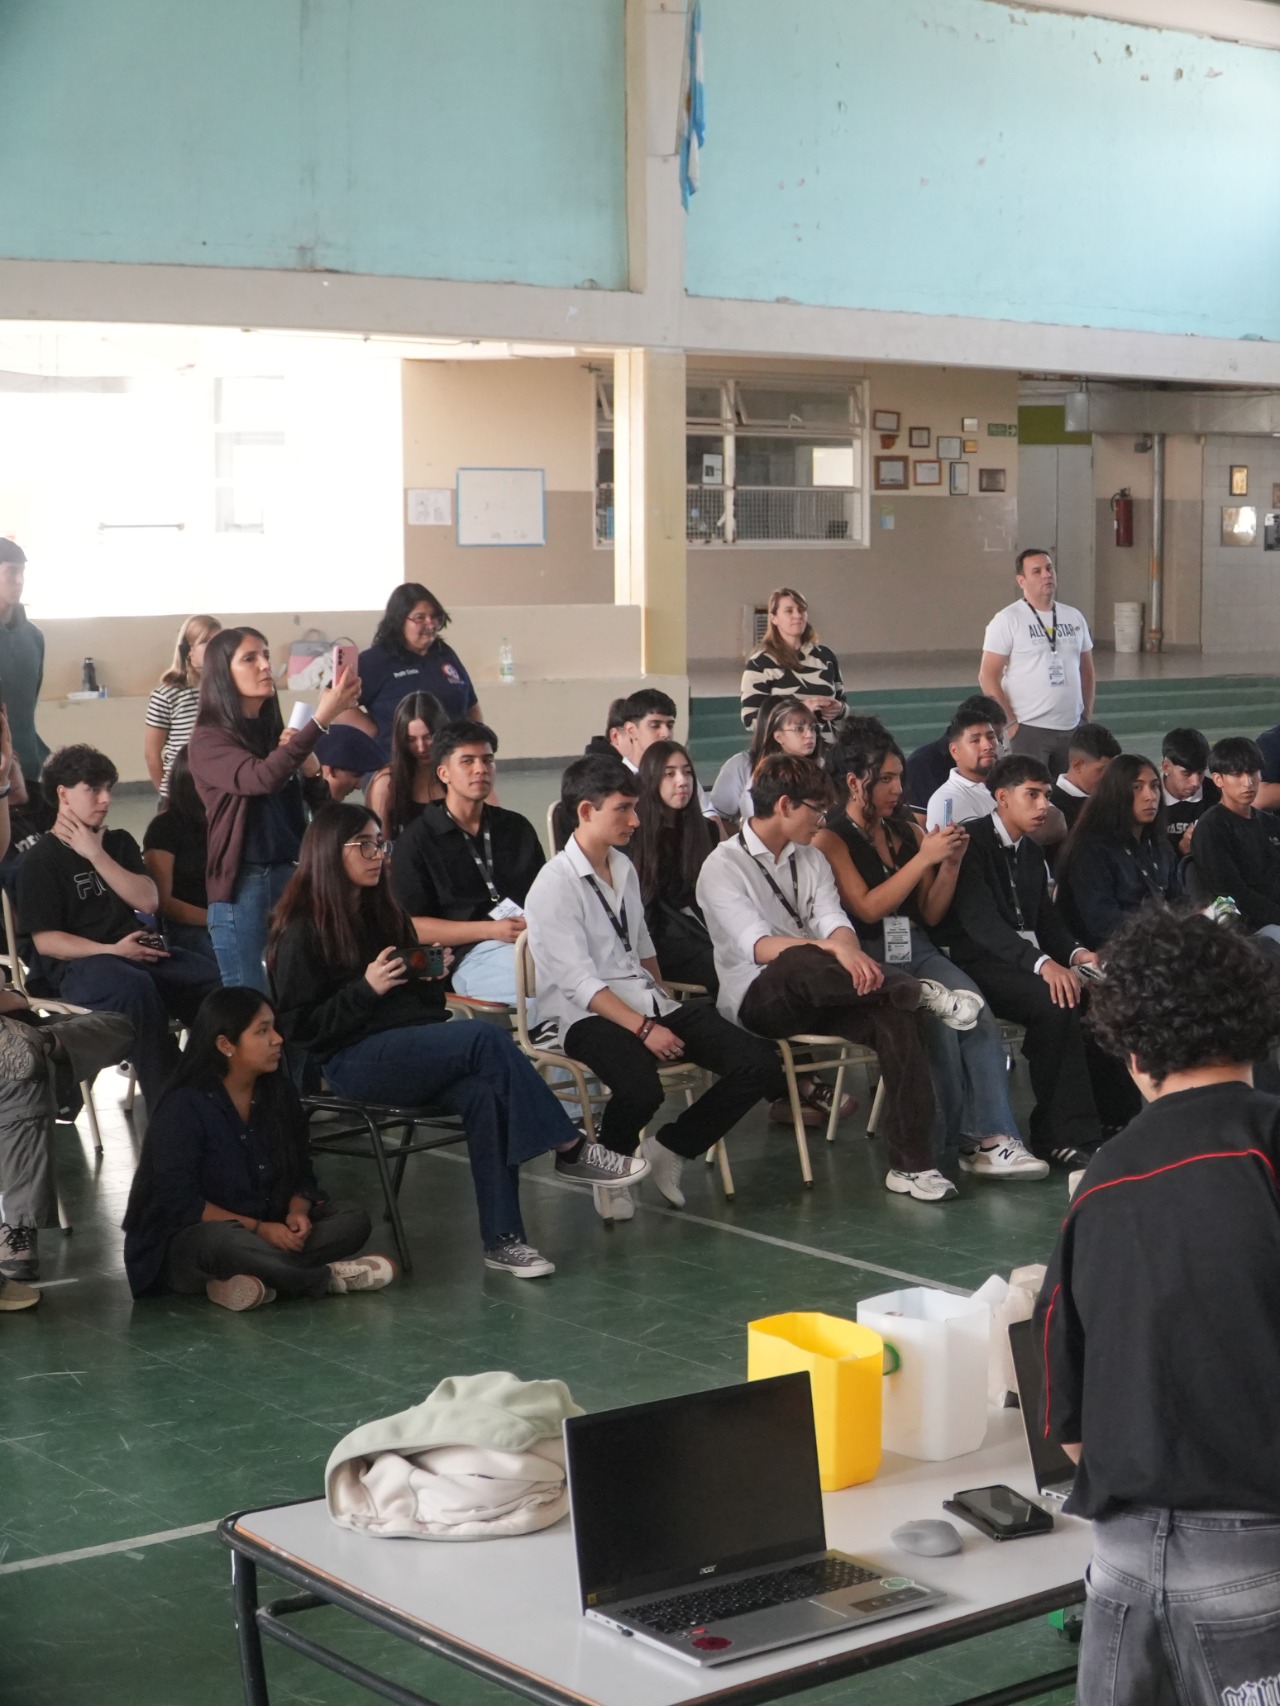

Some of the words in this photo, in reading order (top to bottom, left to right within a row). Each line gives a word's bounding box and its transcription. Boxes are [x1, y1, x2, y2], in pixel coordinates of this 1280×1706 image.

[1029, 624, 1045, 638] ALL
[1056, 624, 1076, 638] STAR
[73, 870, 107, 900] FI
[998, 1148, 1014, 1160] N
[699, 1565, 716, 1575] acer
